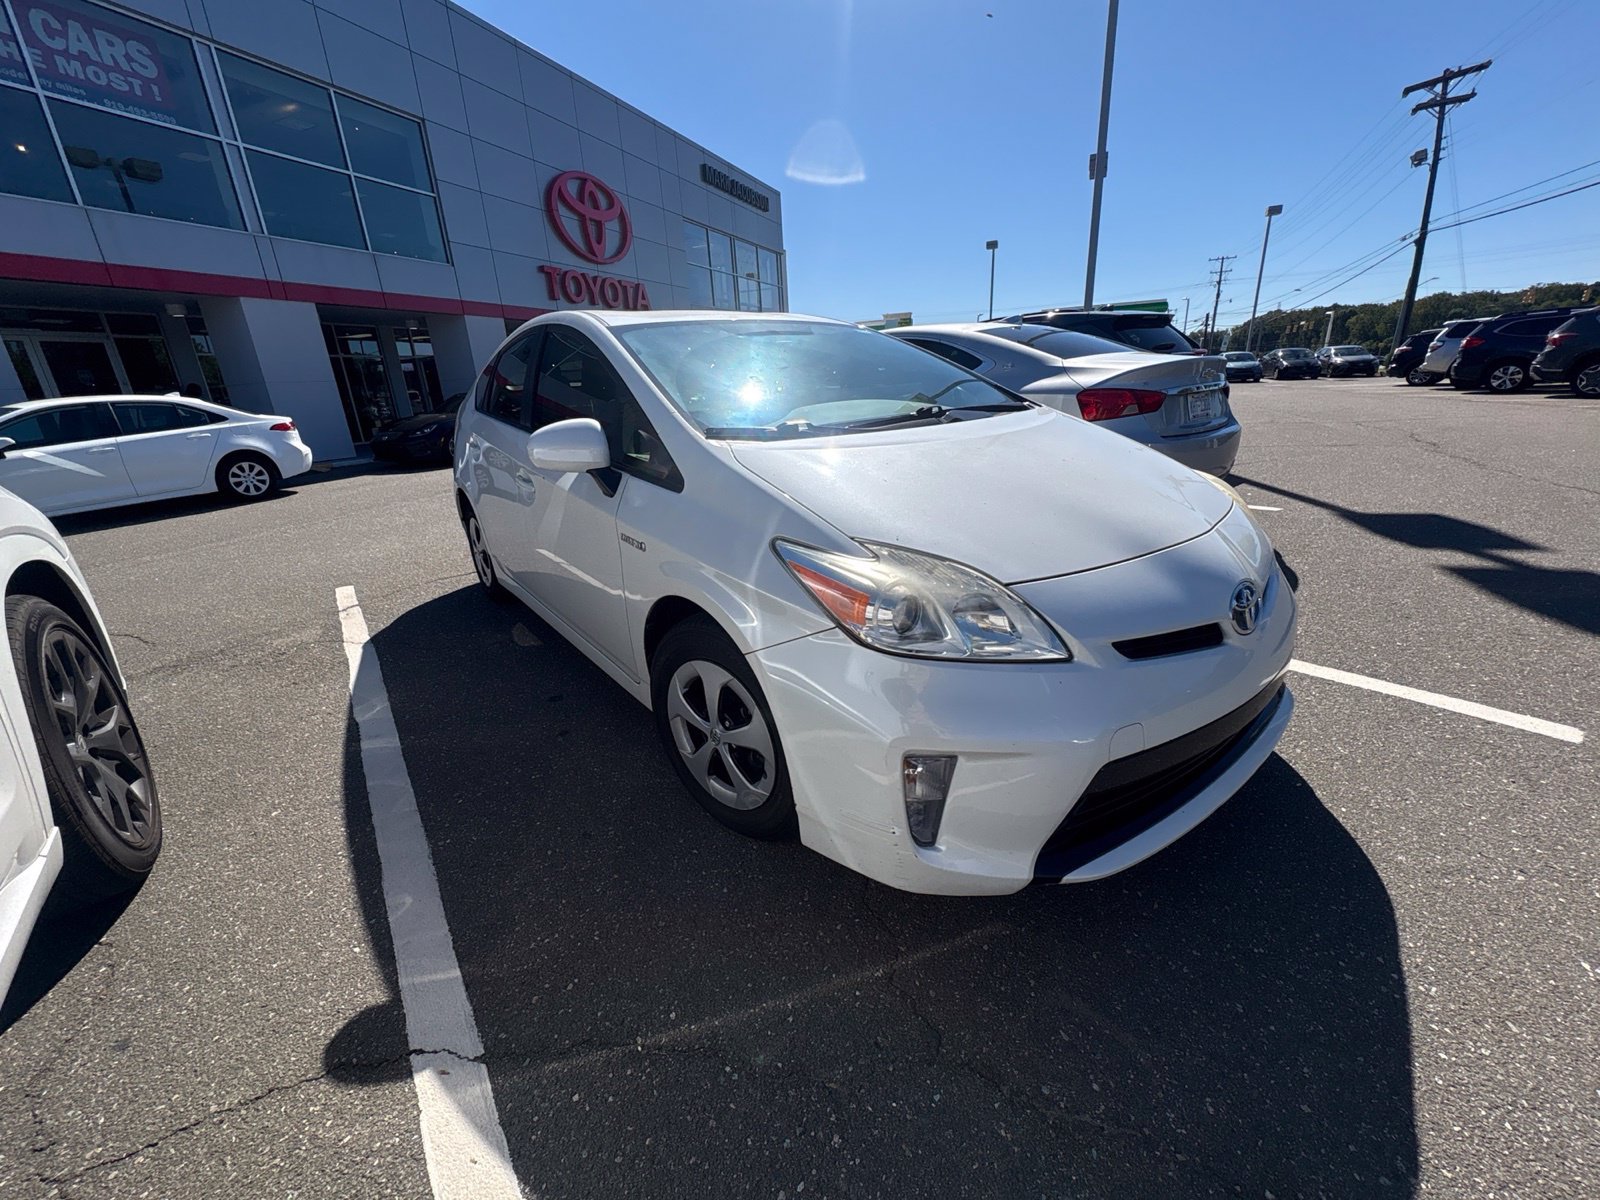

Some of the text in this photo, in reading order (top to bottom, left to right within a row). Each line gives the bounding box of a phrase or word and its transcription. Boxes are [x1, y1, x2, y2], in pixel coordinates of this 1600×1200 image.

[28, 8, 158, 79] CARS
[54, 54, 143, 96] MOST
[538, 264, 651, 311] TOYOTA
